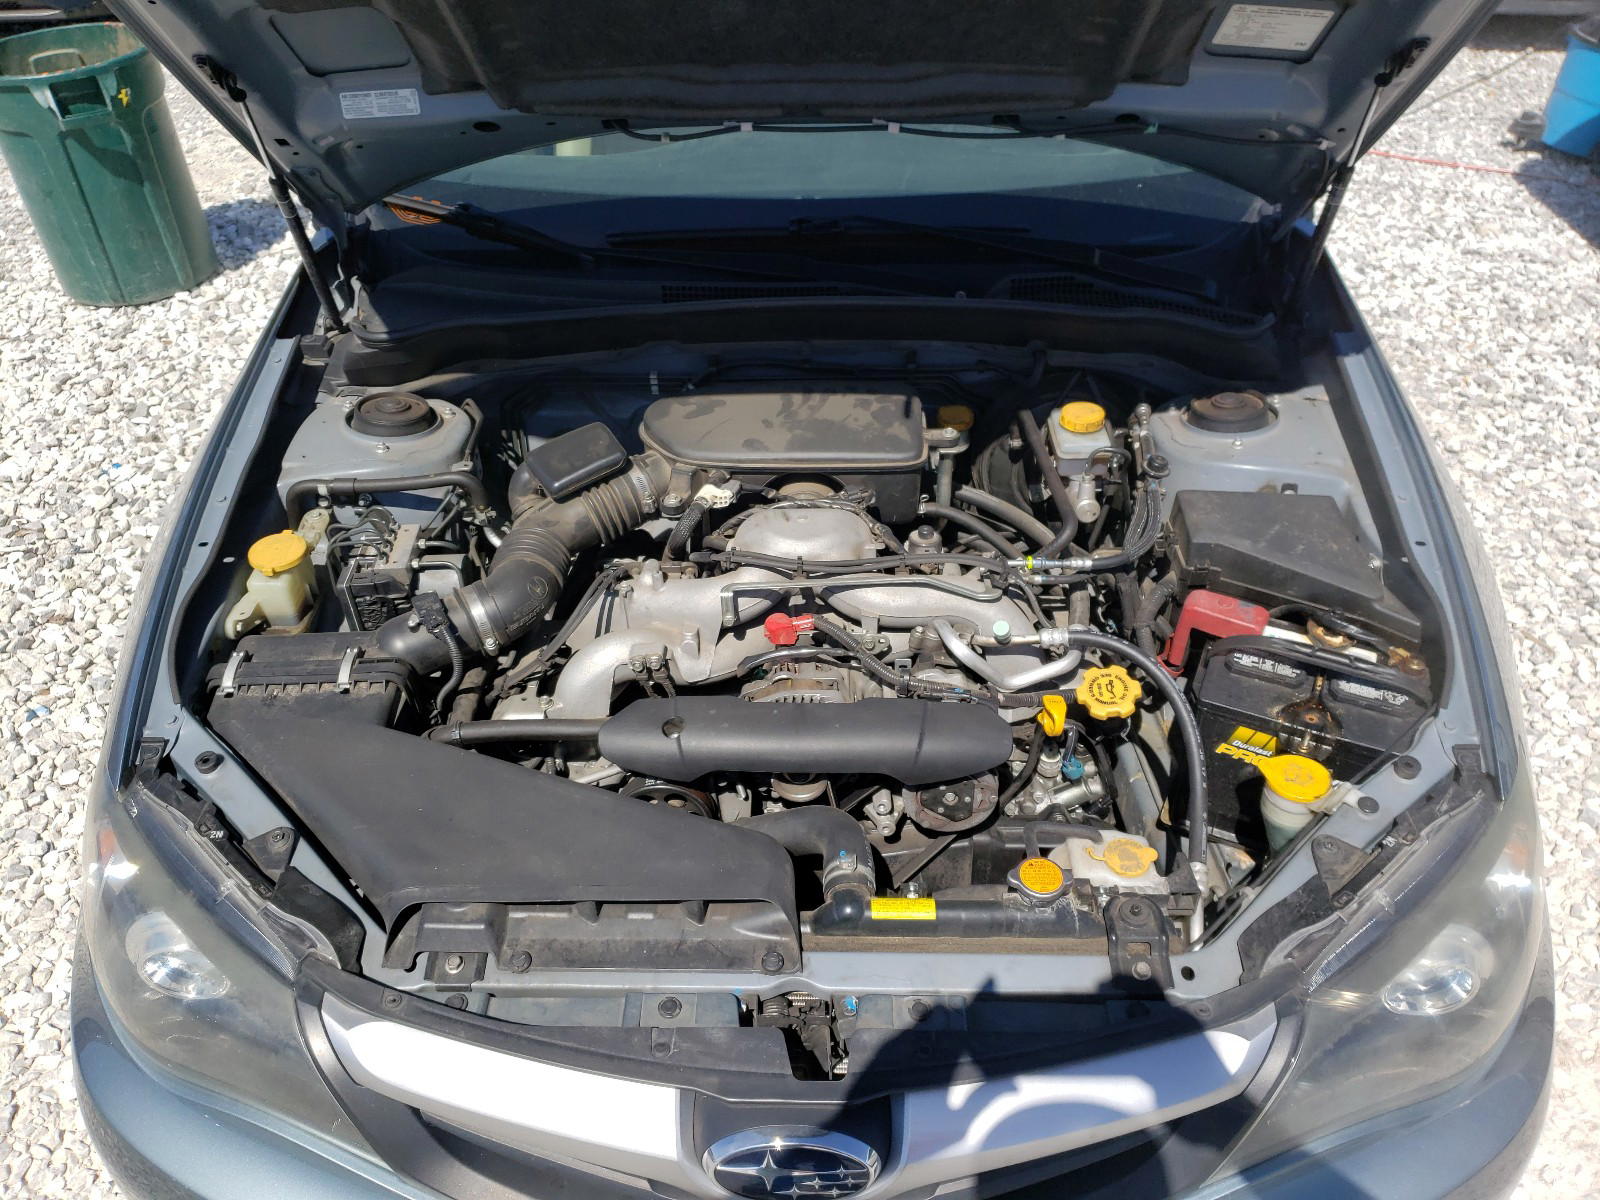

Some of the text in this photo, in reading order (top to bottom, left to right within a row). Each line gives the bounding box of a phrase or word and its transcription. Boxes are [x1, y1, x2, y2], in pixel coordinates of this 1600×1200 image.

[1114, 675, 1128, 691] ENGINE
[1232, 740, 1273, 757] Duralast
[209, 830, 224, 839] 2N
